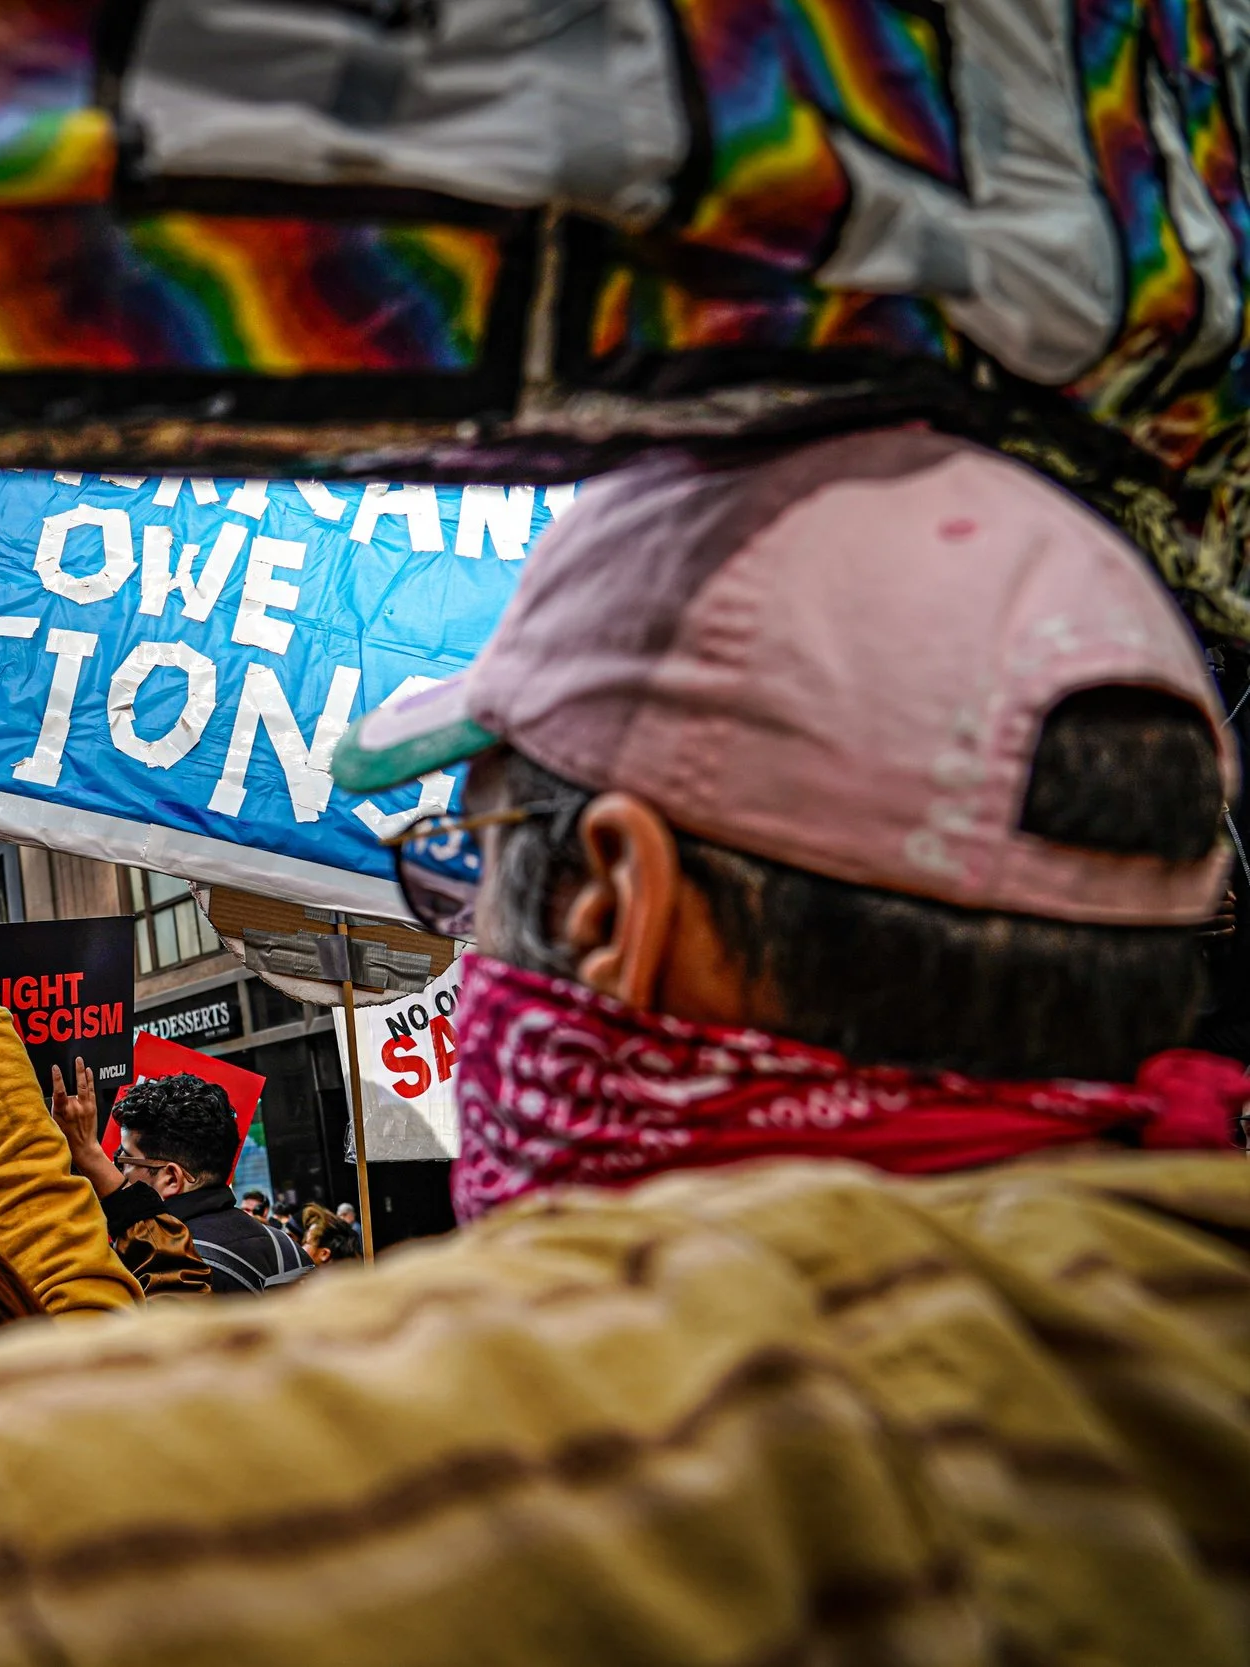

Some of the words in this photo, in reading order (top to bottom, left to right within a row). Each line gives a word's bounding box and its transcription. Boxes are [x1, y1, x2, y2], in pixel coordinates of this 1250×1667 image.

[34, 503, 307, 655] OWE
[158, 1001, 230, 1040] DESSERTS
[385, 1003, 429, 1043] NO
[100, 1063, 126, 1081] NYCLU
